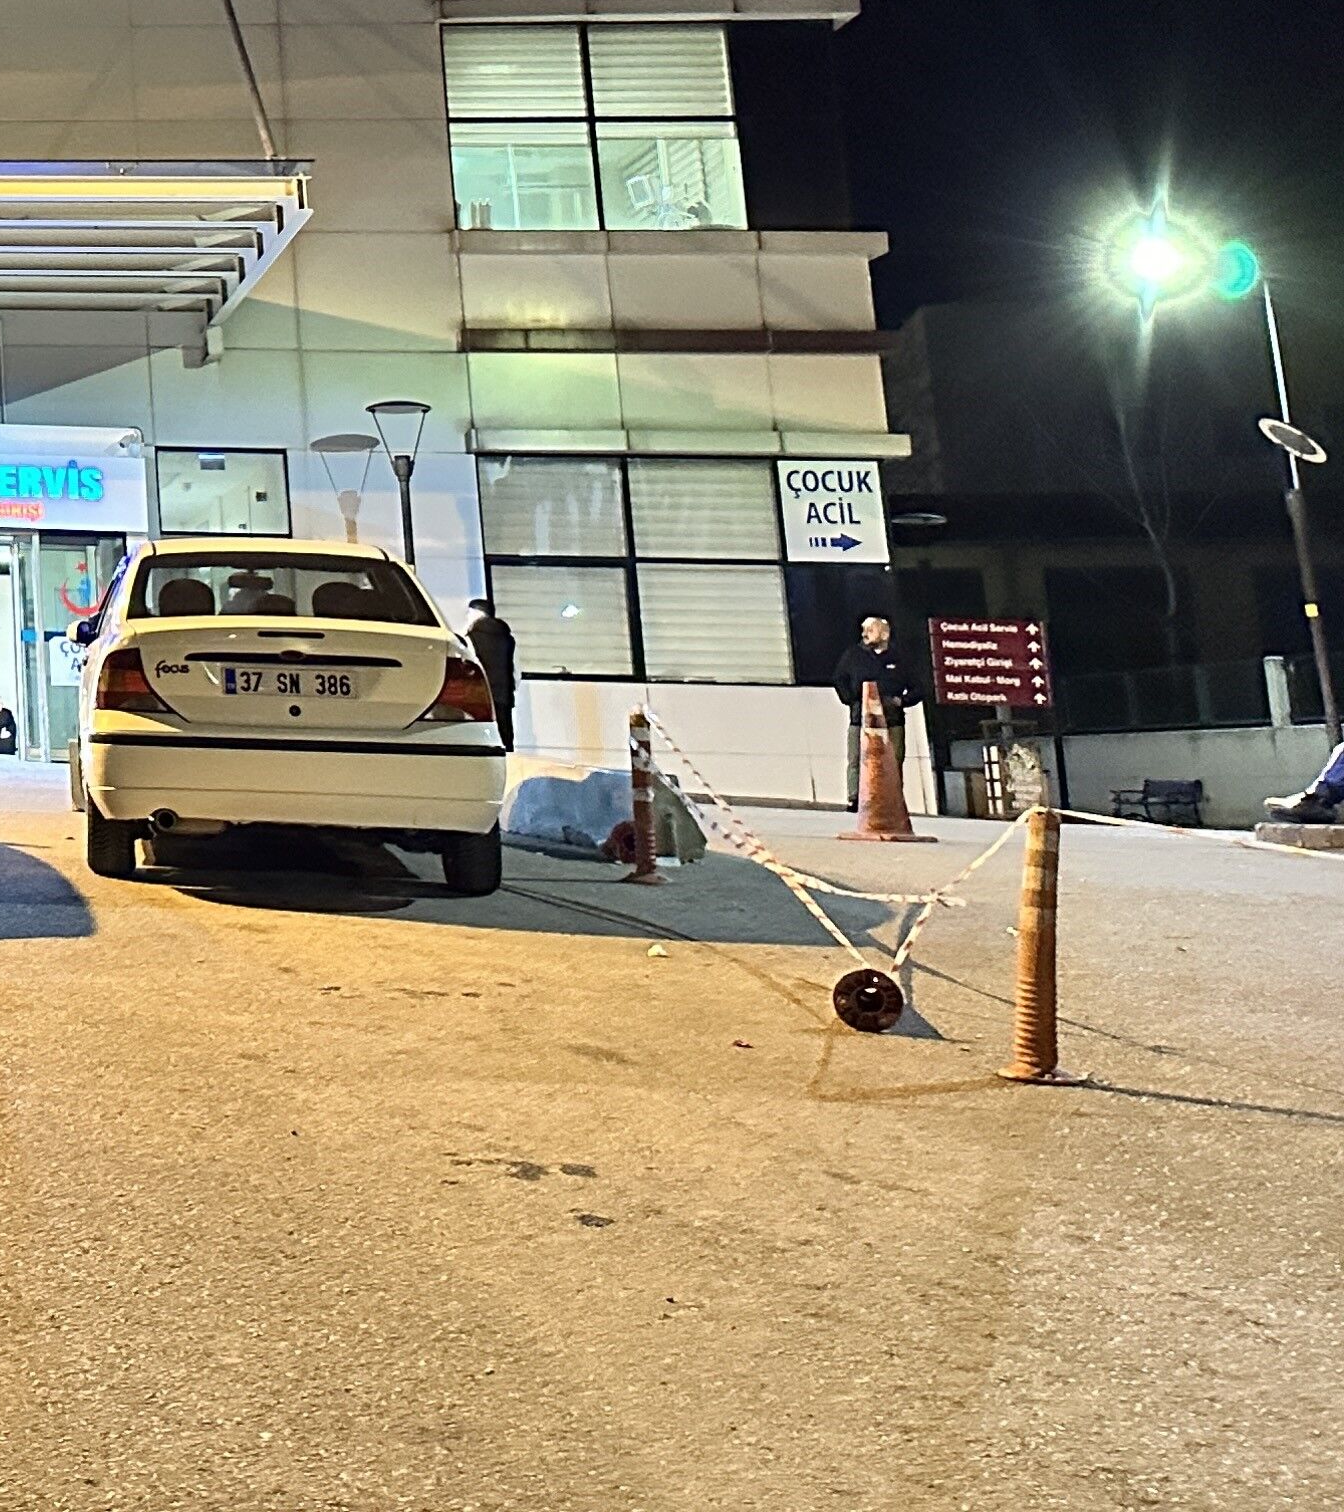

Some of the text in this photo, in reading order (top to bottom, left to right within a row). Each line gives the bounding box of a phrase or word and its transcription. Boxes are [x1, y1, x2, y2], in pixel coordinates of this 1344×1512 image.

[786, 470, 874, 499] ÇOCUK
[806, 497, 861, 524] ACİL
[240, 671, 351, 696] 37 SN 386
